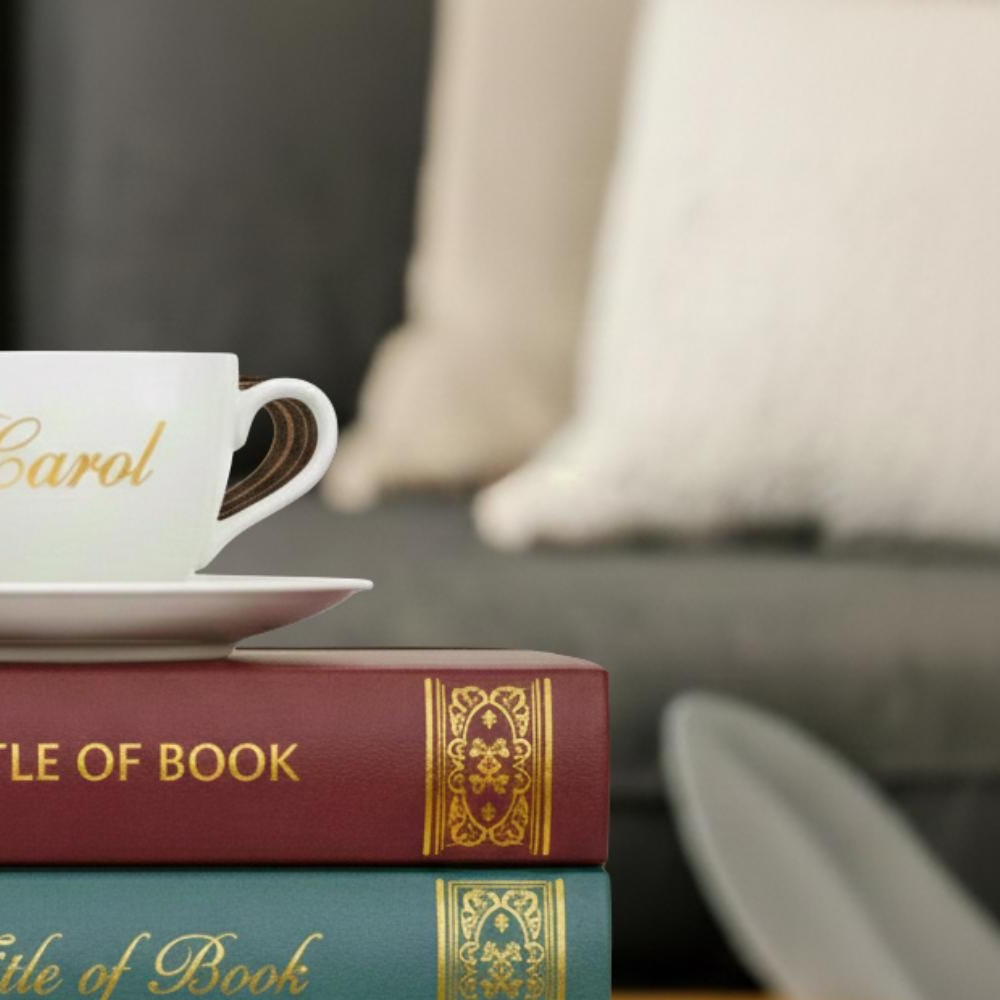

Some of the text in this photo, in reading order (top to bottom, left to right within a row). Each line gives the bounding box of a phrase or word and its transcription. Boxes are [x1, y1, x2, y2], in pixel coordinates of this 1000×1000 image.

[76, 742, 142, 782] OF
[159, 742, 300, 782] BOOK
[148, 932, 324, 996] Book
